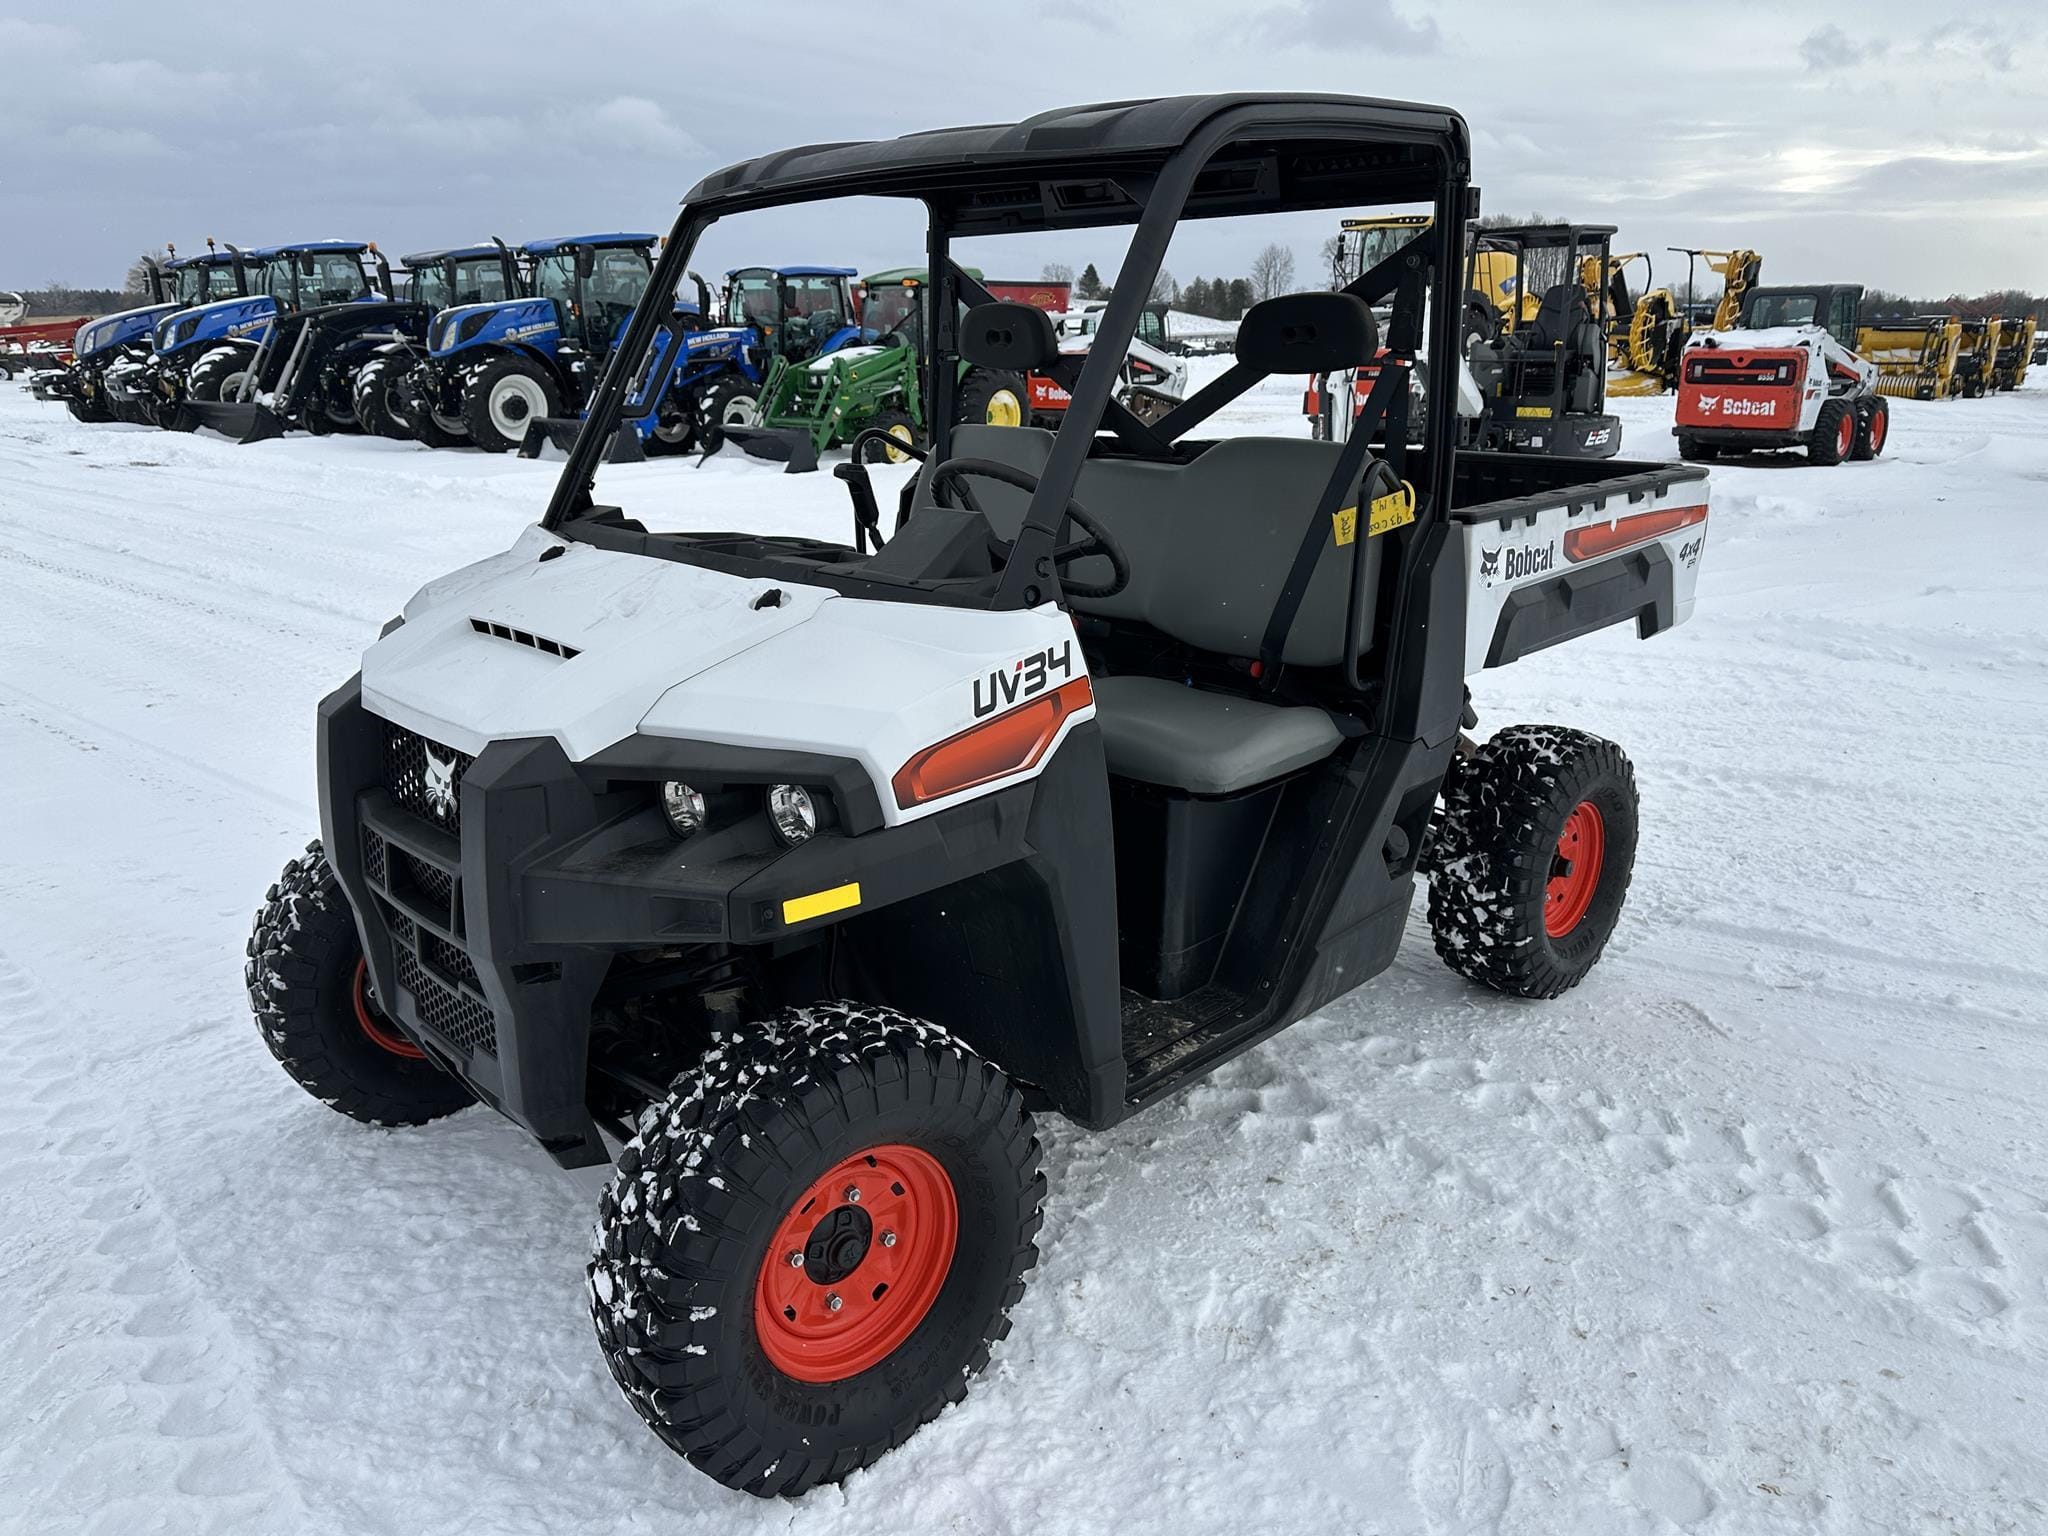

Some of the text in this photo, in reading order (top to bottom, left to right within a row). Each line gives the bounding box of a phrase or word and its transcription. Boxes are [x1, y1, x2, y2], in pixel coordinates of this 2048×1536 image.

[1722, 398, 1776, 417] Bobcat
[1584, 428, 1611, 447] E26
[1505, 539, 1554, 581] Bobcat
[1679, 537, 1702, 562] 4x4
[973, 639, 1071, 719] UV34
